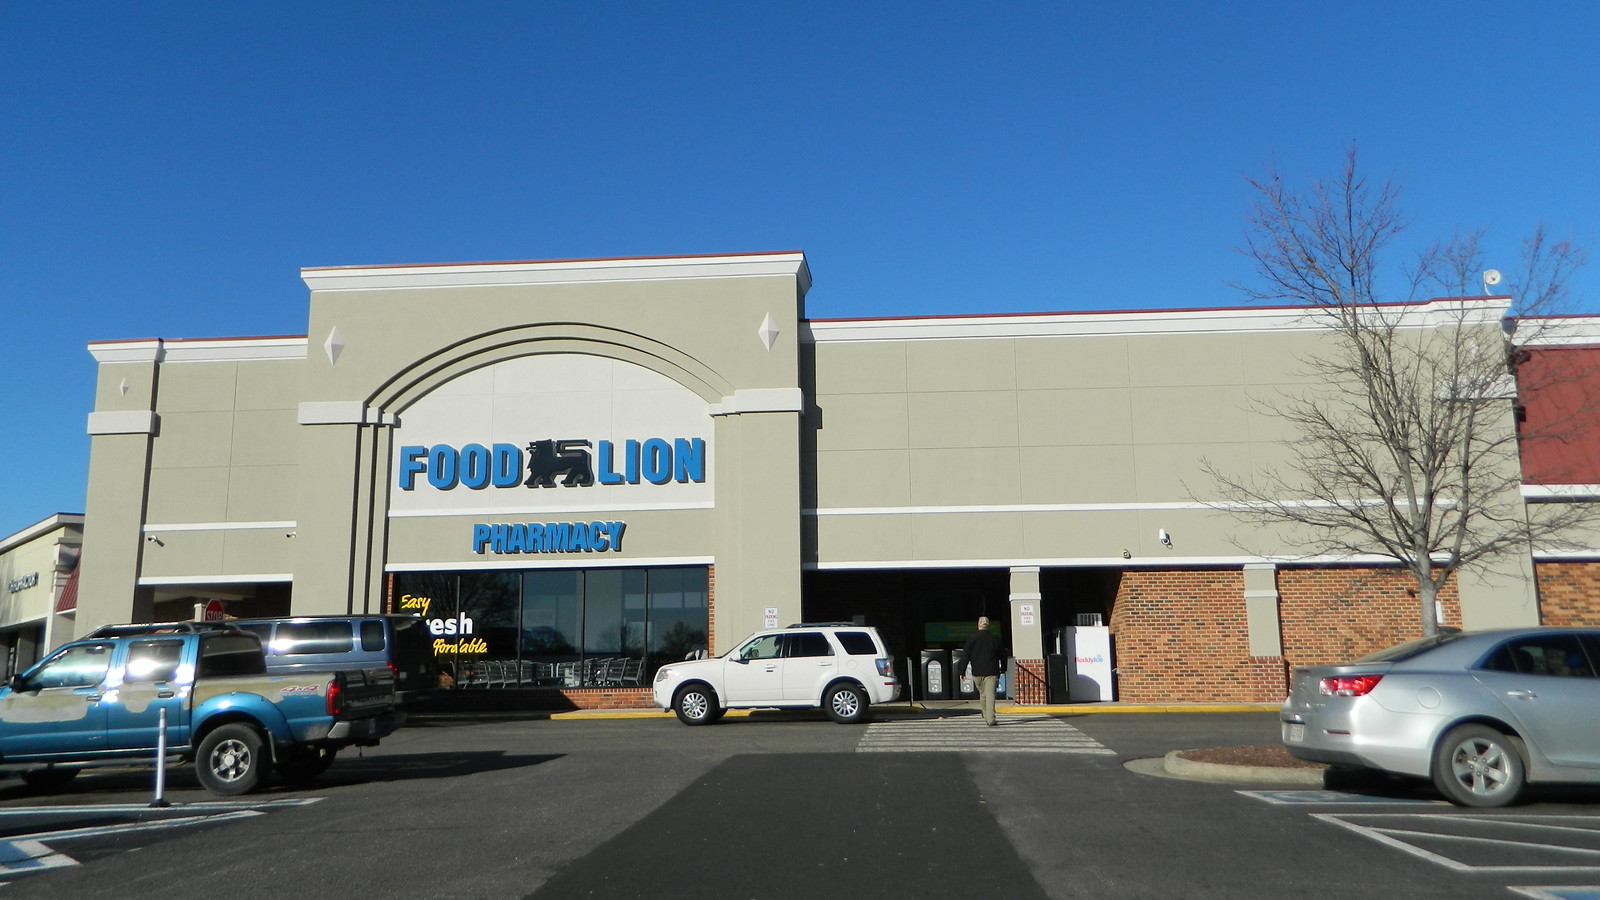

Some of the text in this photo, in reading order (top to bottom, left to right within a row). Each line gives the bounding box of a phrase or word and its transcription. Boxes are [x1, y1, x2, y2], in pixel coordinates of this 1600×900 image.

[399, 437, 706, 491] FOOD LION
[473, 520, 627, 555] PHARMACY
[206, 610, 223, 621] STOP
[401, 594, 431, 617] Easy
[413, 611, 473, 635] esh
